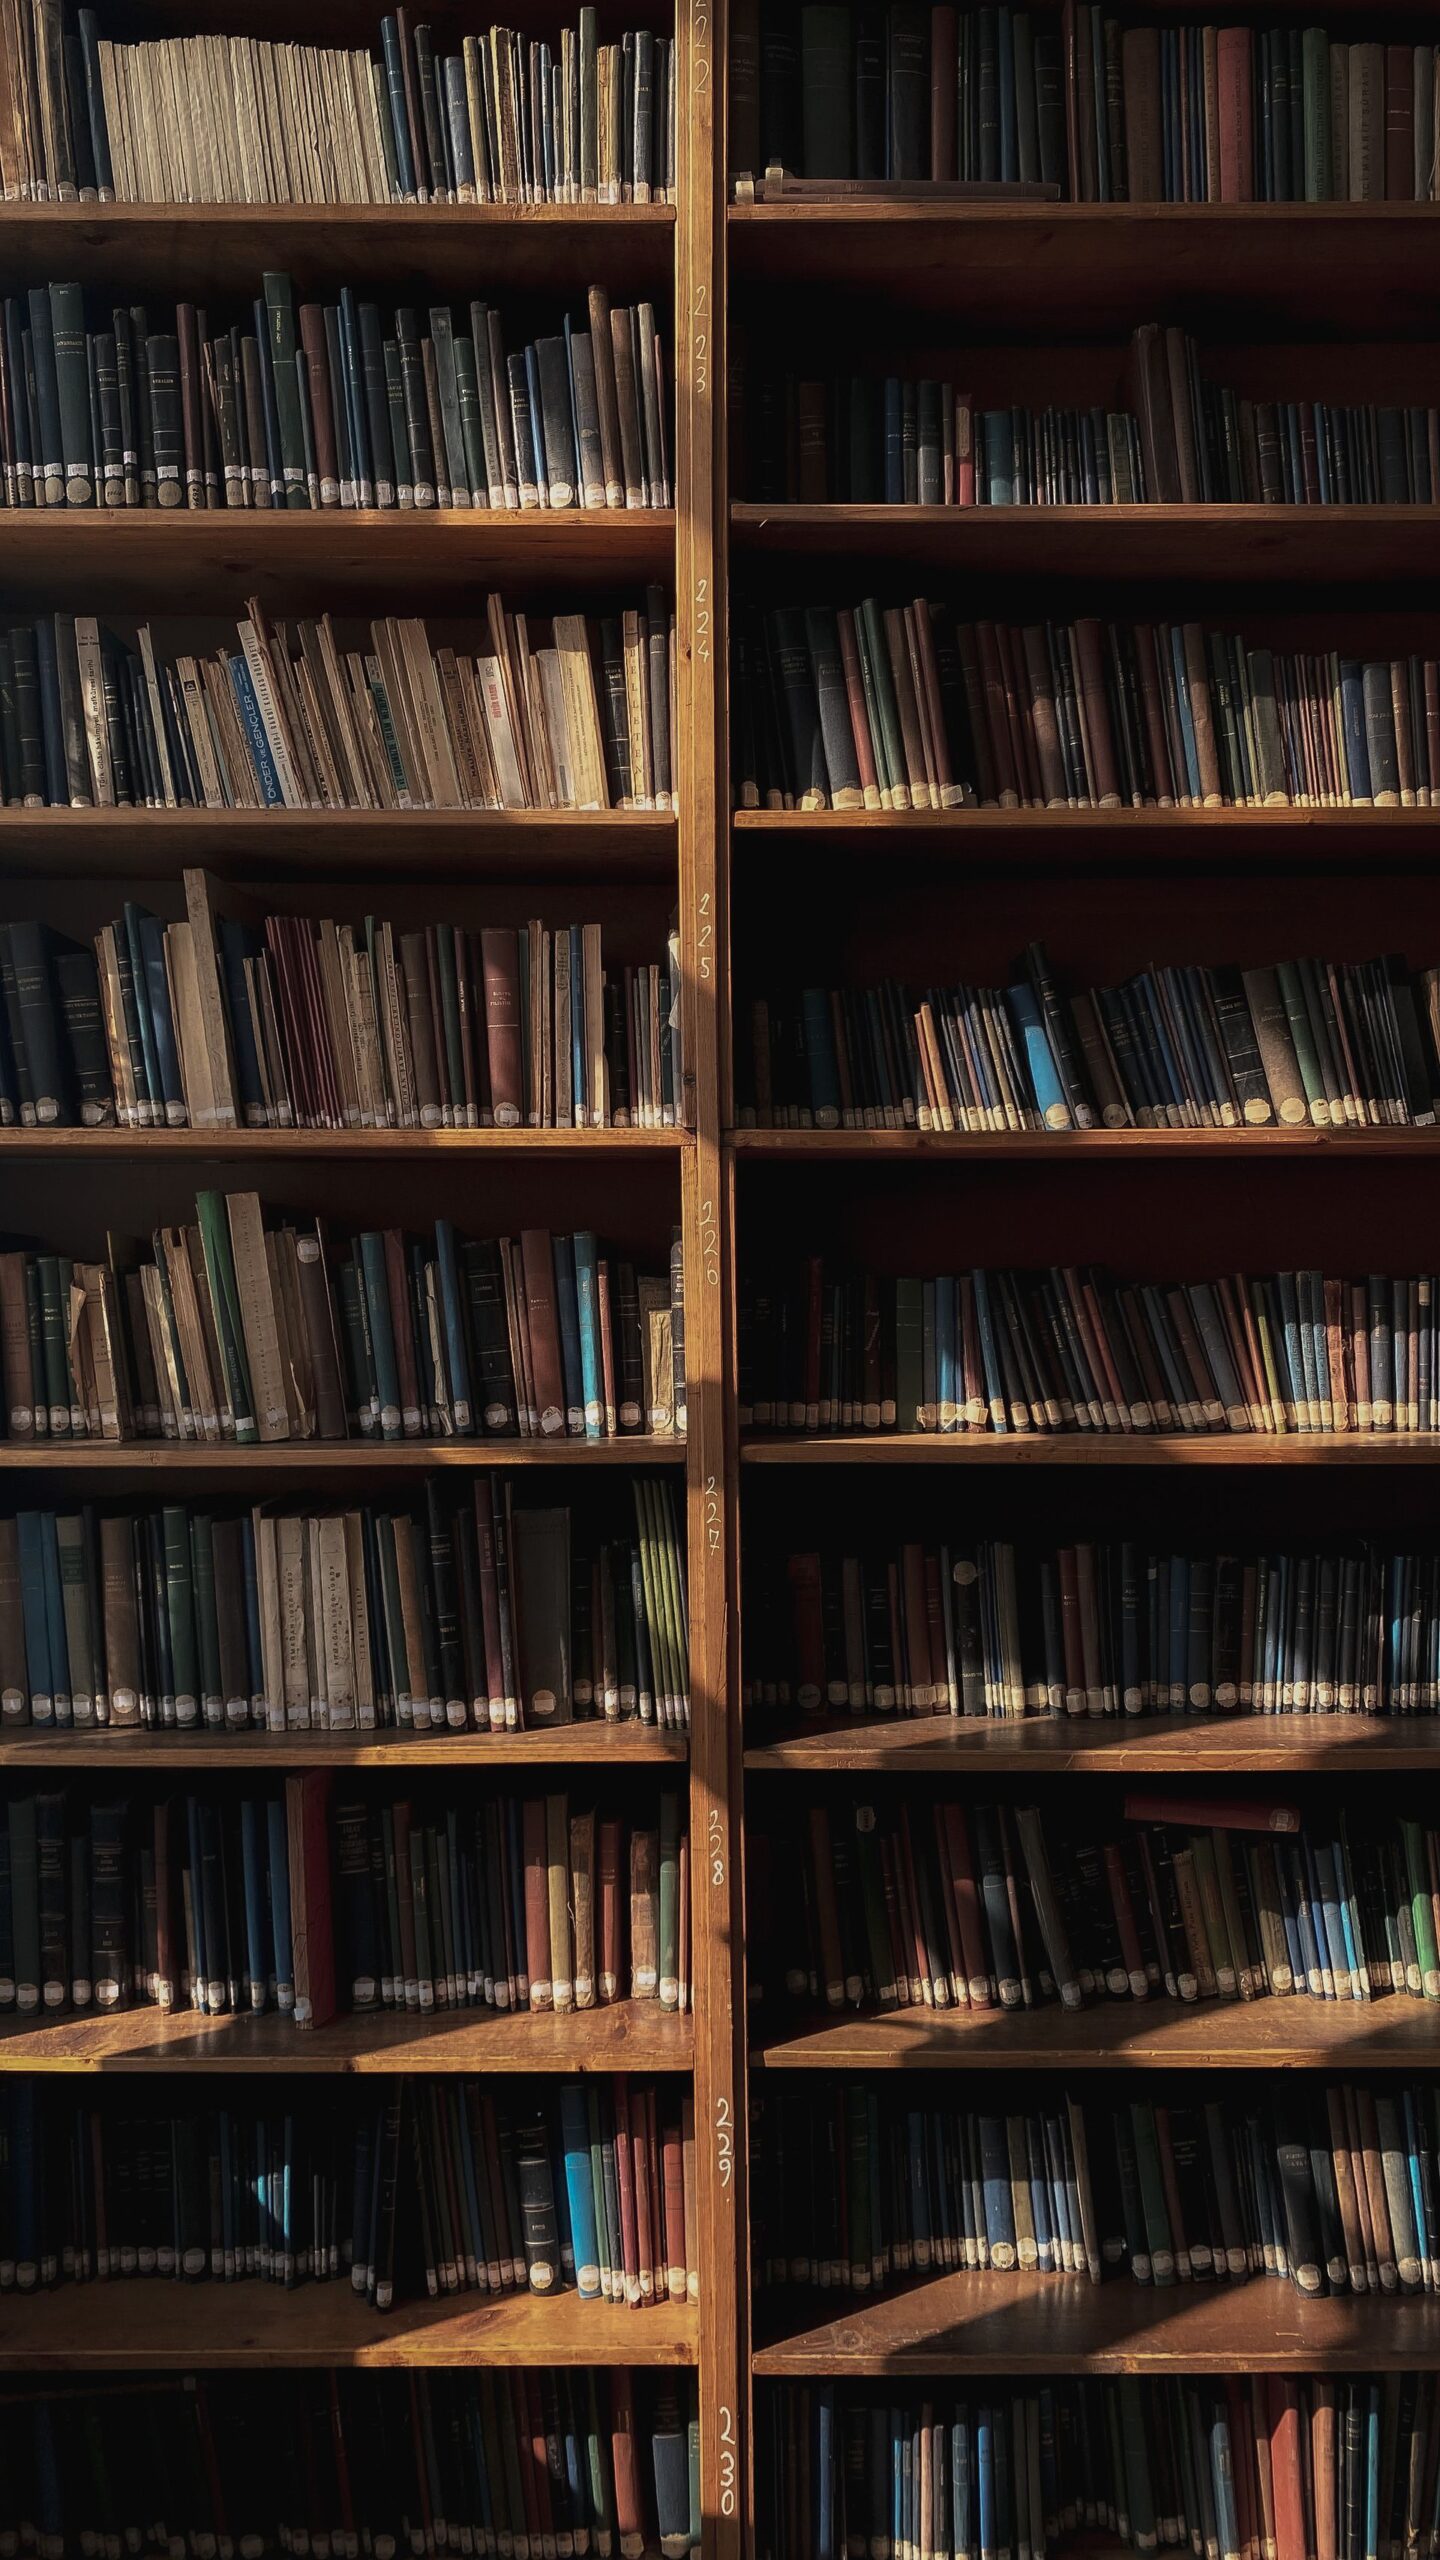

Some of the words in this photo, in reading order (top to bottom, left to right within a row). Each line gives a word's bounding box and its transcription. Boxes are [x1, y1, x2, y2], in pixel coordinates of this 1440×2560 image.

[694, 0, 709, 93] 22
[695, 285, 708, 393] 223
[695, 579, 709, 662] 224
[243, 694, 266, 748] GENÇLER
[259, 760, 276, 799] ÖNDER
[697, 893, 711, 978] 225
[700, 1200, 718, 1285] 226
[705, 1476, 721, 1556] 227
[709, 1809, 724, 1885] 228
[716, 2097, 732, 2188] 229
[719, 2406, 736, 2516] 230
